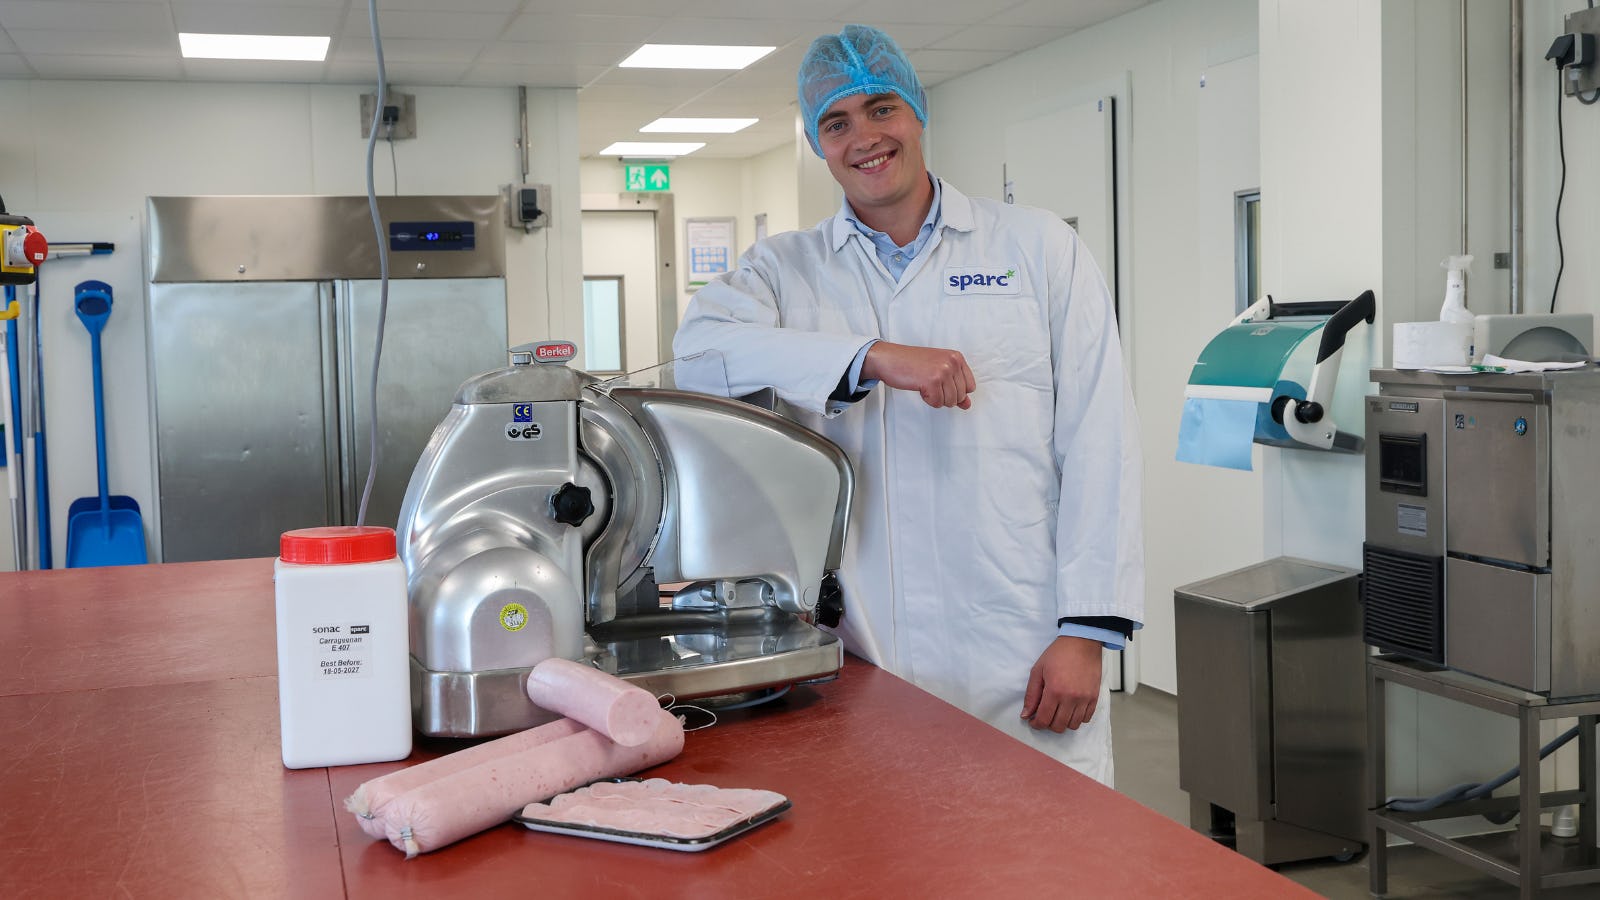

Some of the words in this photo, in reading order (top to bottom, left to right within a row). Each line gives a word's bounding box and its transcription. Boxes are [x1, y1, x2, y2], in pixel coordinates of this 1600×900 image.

[949, 273, 1008, 291] sparc
[540, 346, 570, 357] Berkel
[515, 406, 530, 417] CE
